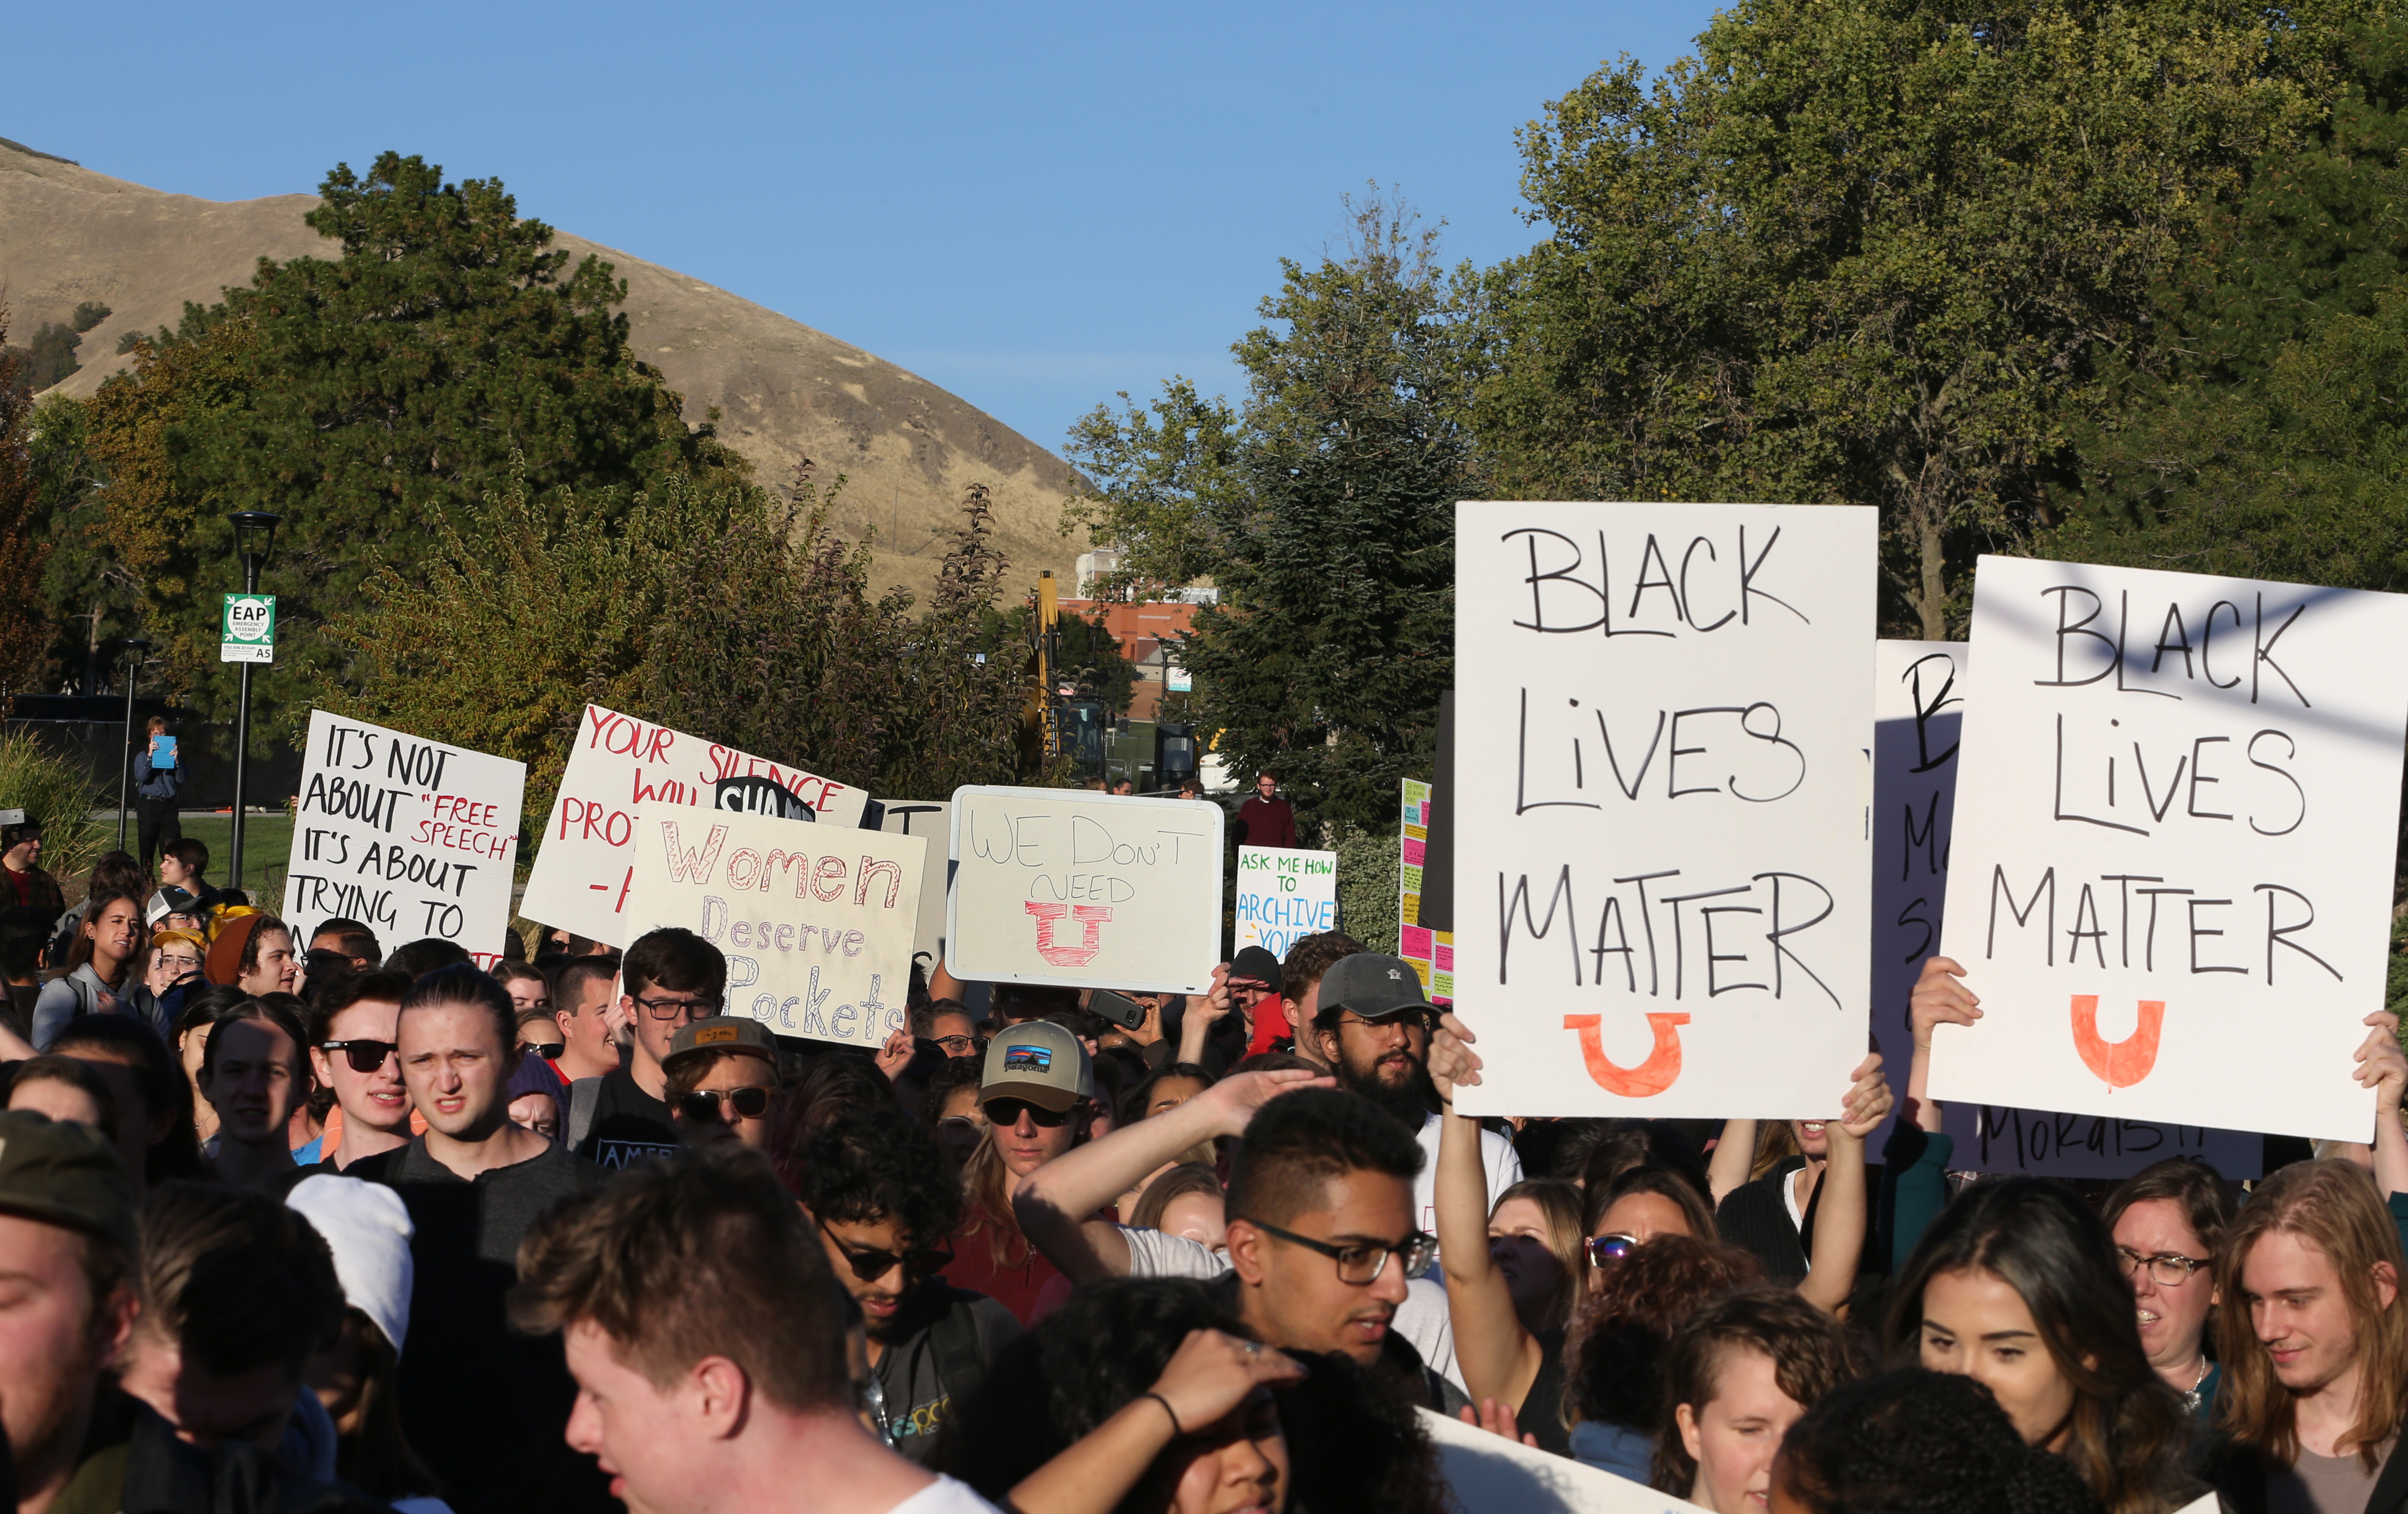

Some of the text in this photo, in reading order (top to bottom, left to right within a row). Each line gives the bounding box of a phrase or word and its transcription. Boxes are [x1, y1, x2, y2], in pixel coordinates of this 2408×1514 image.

[1501, 524, 1811, 639] BLACK
[233, 606, 267, 621] EAP
[256, 649, 270, 658] A5
[2033, 585, 2311, 707] BLACK
[326, 724, 458, 791] IT'S NOT
[588, 705, 674, 765] YOUR
[302, 773, 413, 833] ABOUT
[305, 827, 478, 897] IT'S ABOUT
[661, 820, 902, 909] Women
[971, 809, 1051, 867] WE
[1240, 853, 1334, 875] ASK ME HOW
[289, 875, 464, 938] TRYING TO
[1030, 874, 1135, 903] NEED
[1236, 894, 1334, 929] ARCHIVE
[1277, 876, 1297, 892] TO
[703, 895, 865, 957] Deserve
[1499, 863, 1843, 1011] MATTER
[1986, 863, 2344, 986] MATTER
[1005, 1064, 1048, 1074] patagonia
